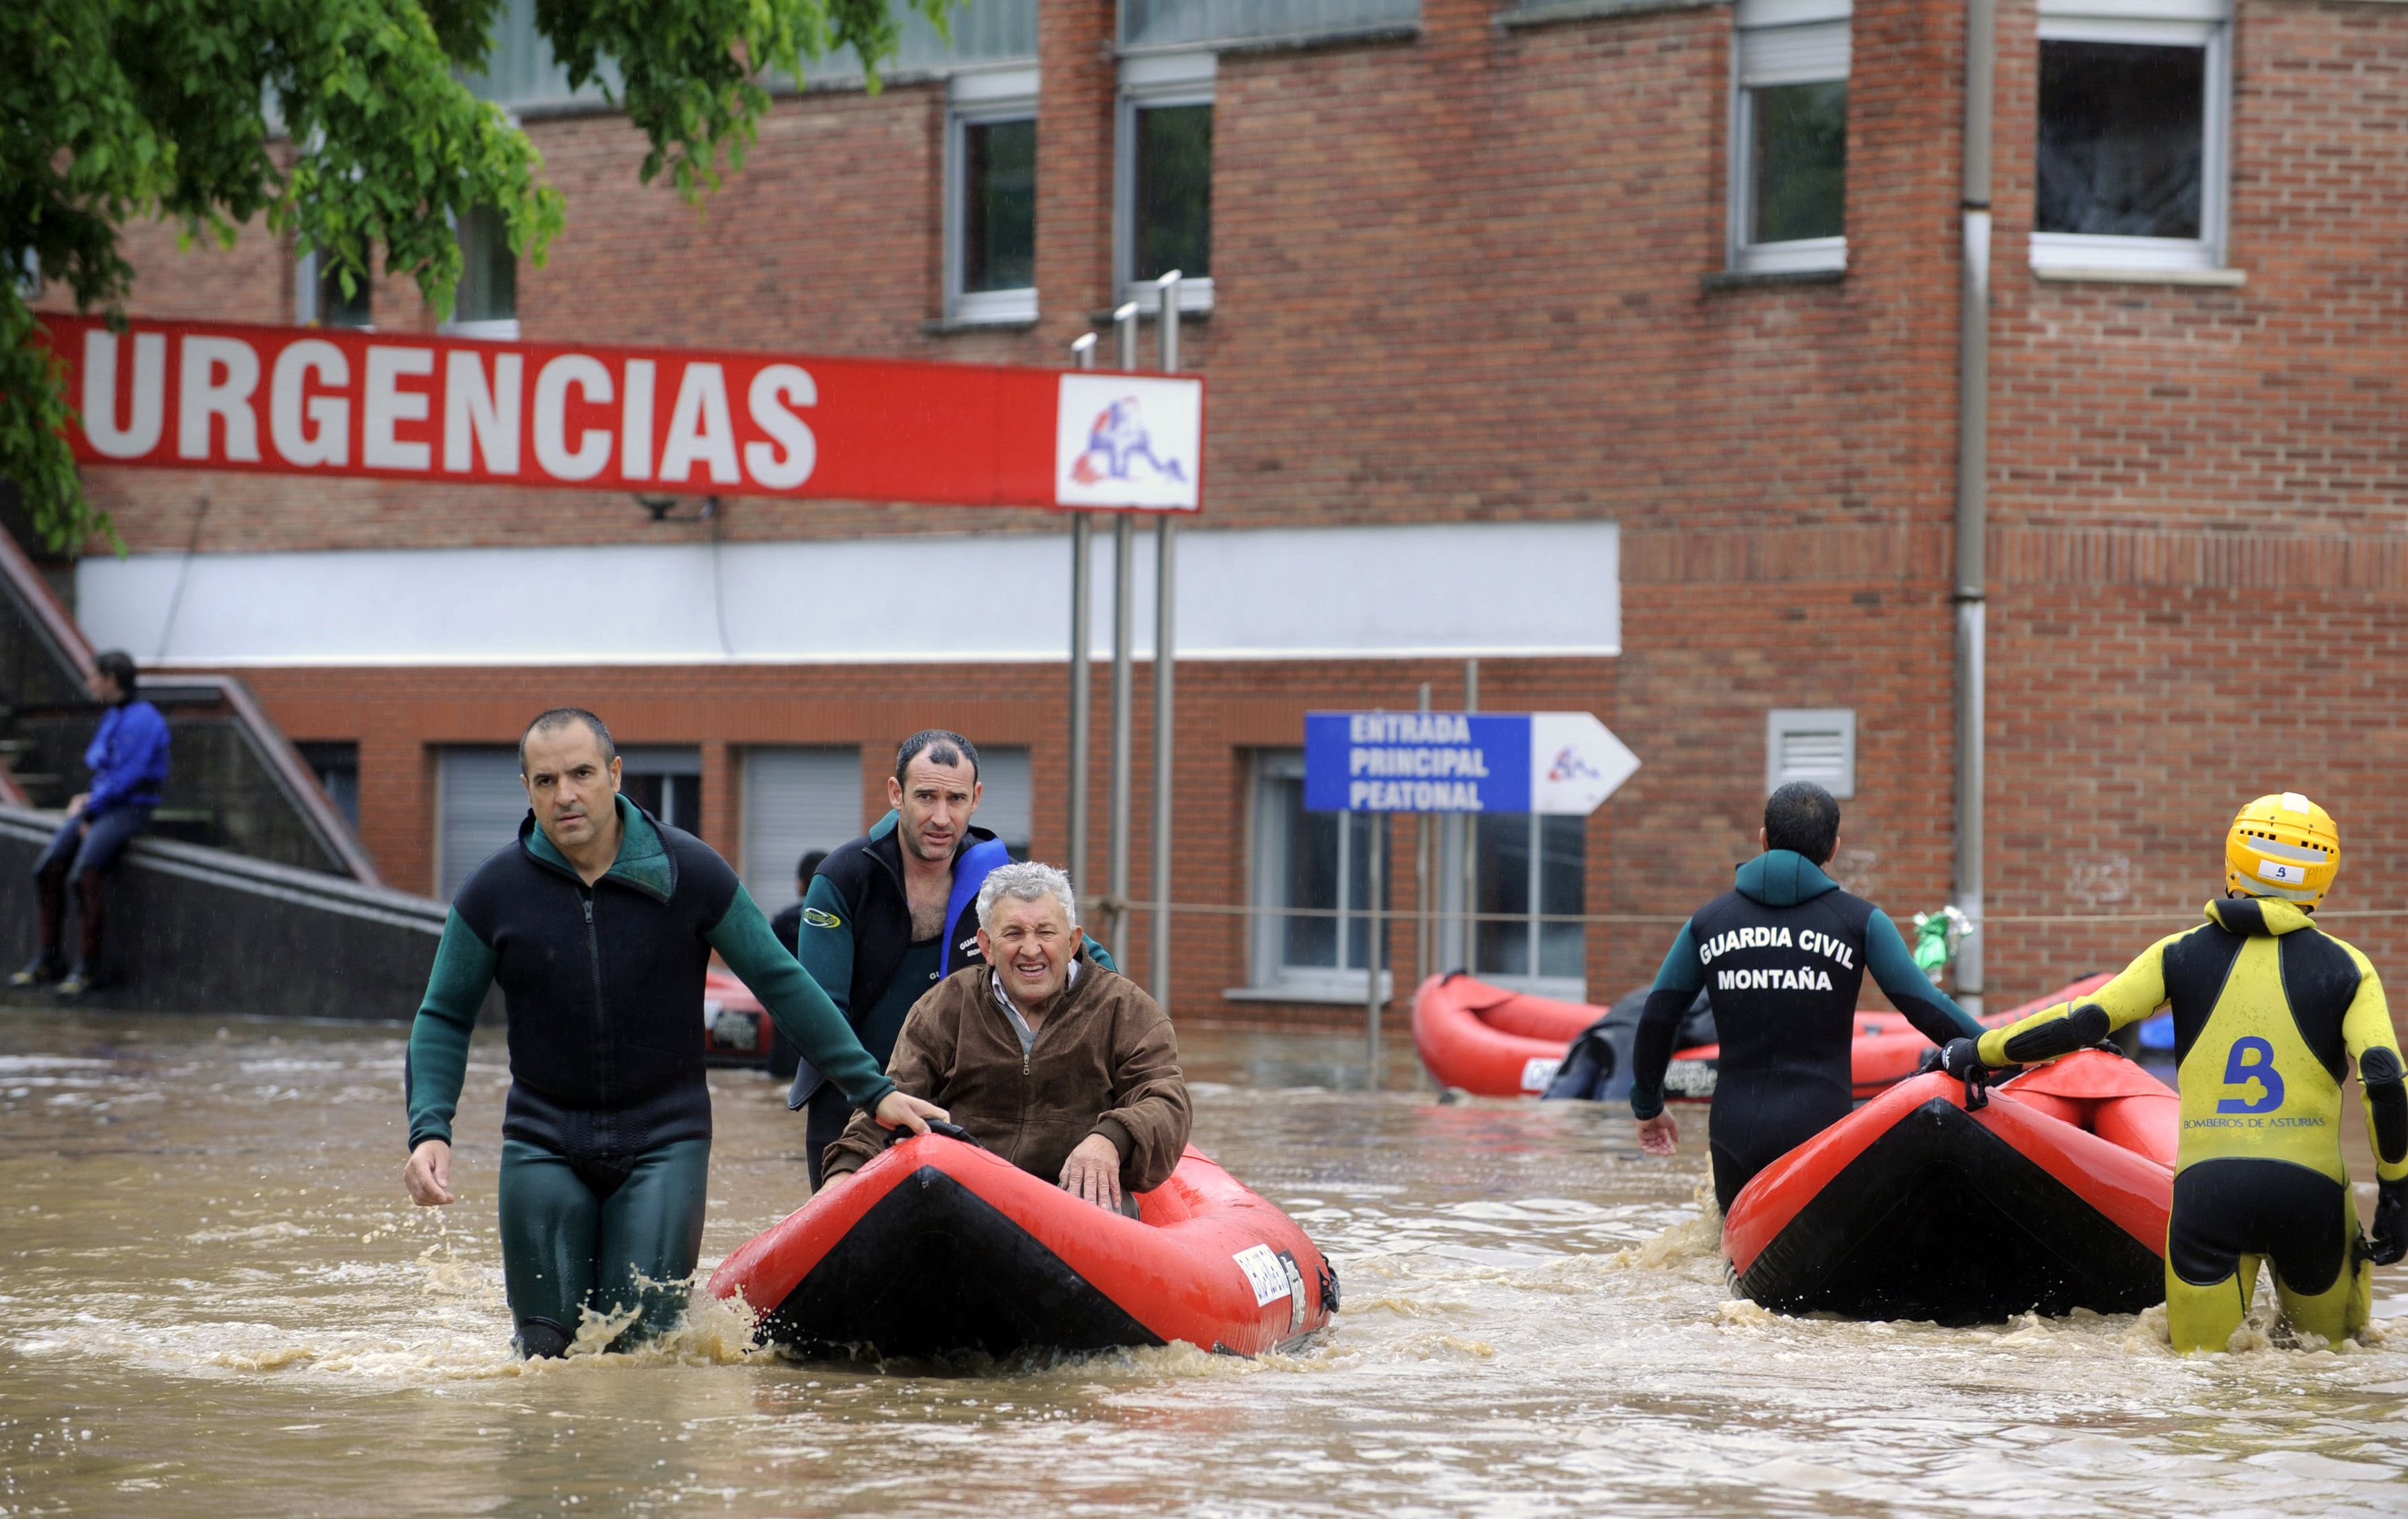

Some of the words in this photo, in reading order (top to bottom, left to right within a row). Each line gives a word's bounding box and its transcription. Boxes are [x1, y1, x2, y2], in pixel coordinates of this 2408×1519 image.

[83, 330, 817, 489] URGENCIAS
[1350, 713, 1472, 744] ENTRADA
[1349, 746, 1490, 778] PRINCIPAL
[1349, 779, 1484, 811] PEATONAL
[1699, 927, 1792, 965] GUARDIA
[1798, 929, 1854, 970] CIVIL
[1717, 966, 1833, 991] MONTAÑA
[2216, 1036, 2285, 1114] B
[2184, 1119, 2243, 1130] BOMBEROS
[2248, 1118, 2264, 1128] DE
[2270, 1117, 2325, 1128] ASTURIAS
